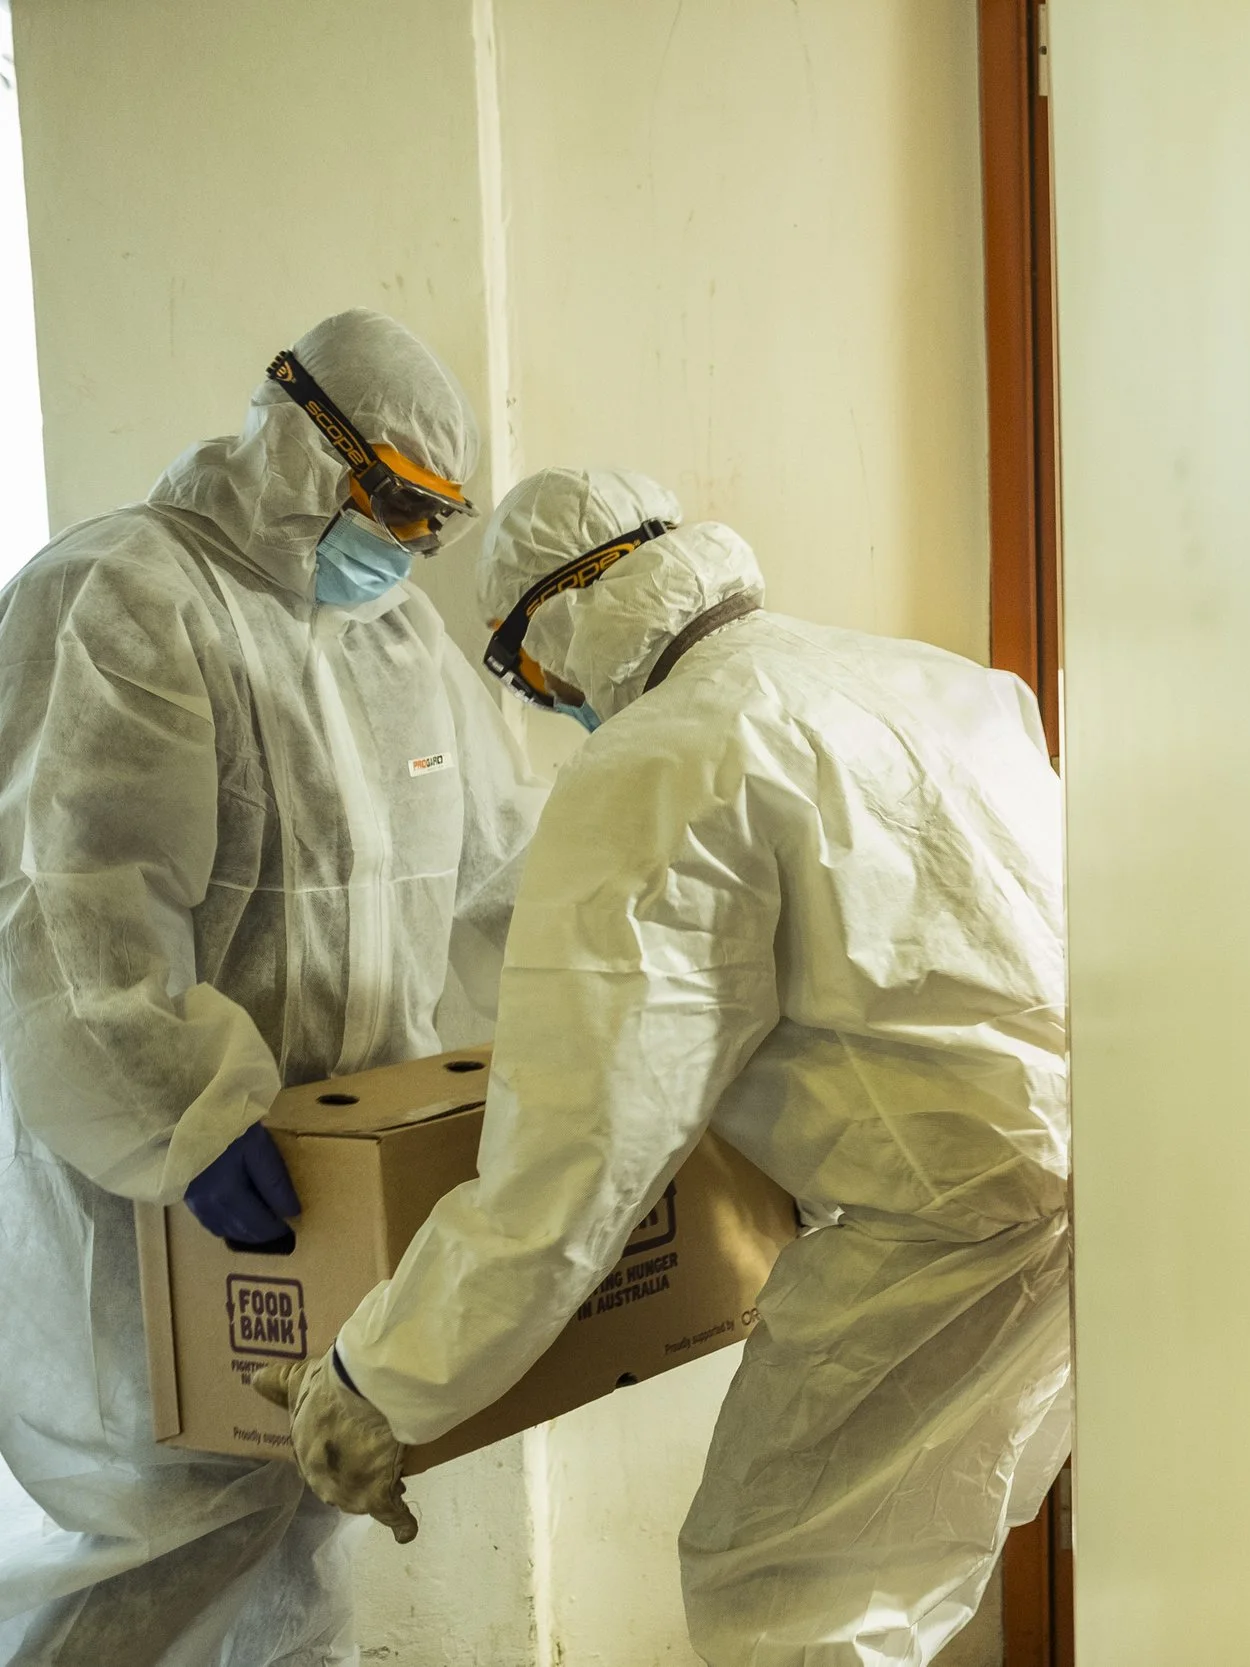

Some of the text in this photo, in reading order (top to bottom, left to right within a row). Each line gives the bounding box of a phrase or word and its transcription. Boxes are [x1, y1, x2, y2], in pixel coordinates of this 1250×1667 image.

[627, 1252, 678, 1282] HUNGER
[239, 1289, 292, 1318] FOOD
[578, 1274, 670, 1321] IN AUSTRALIA
[240, 1316, 294, 1344] BANK
[233, 1426, 261, 1446] Proudly
